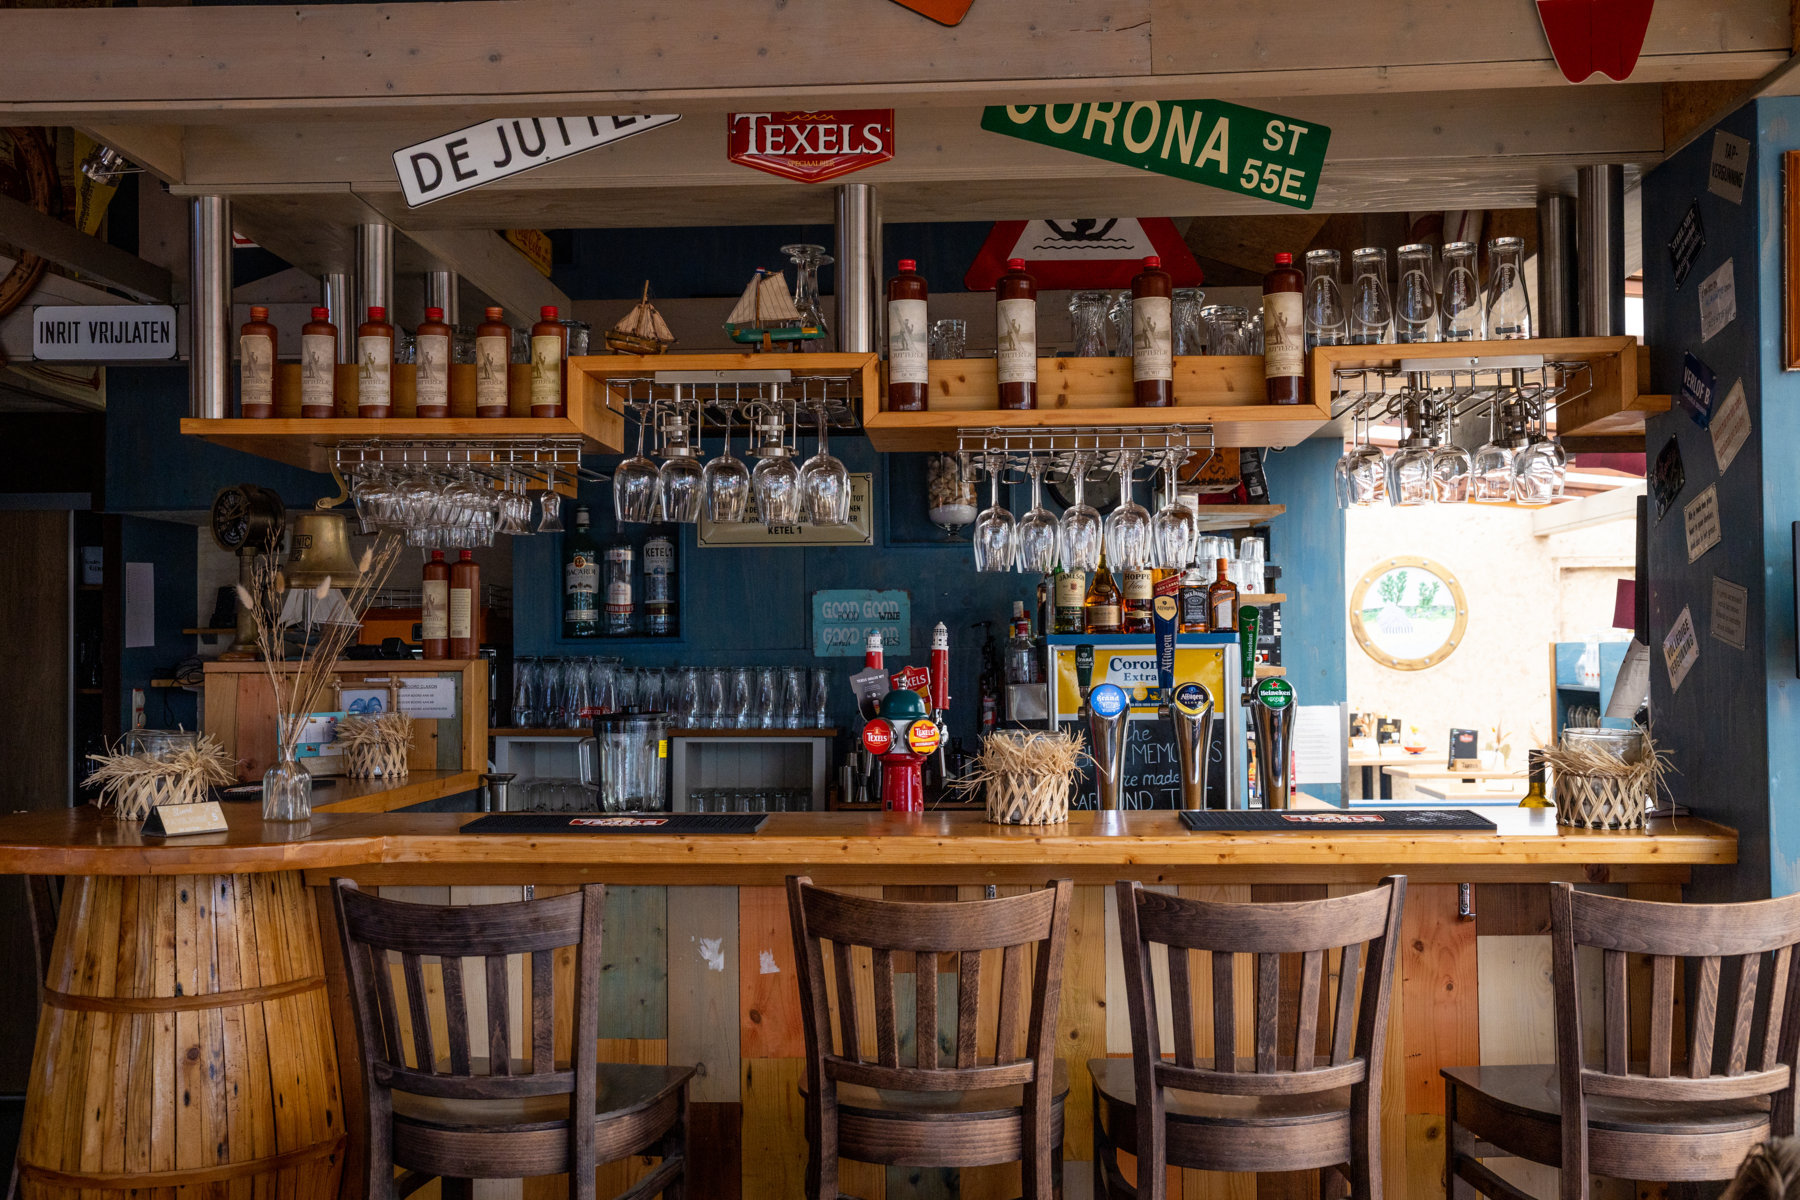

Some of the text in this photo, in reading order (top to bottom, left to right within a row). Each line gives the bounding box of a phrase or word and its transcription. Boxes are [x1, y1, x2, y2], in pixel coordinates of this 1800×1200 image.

[734, 112, 884, 156] TEXELS
[1262, 120, 1309, 156] ST
[1725, 142, 1739, 160] TAP-
[410, 138, 478, 194] DE
[1240, 158, 1307, 202] 55E.
[40, 321, 170, 344] INRIT VRIJLATEN
[1683, 366, 1706, 400] VERLOF
[1703, 386, 1712, 406] B
[768, 526, 802, 535] KETEL 1
[822, 600, 899, 619] GOOD GOOD
[879, 612, 900, 620] WINE
[823, 627, 860, 645] GOOD
[1667, 618, 1690, 661] VOLLEDIGE
[1161, 634, 1173, 673] Affligem
[1246, 633, 1254, 661] Heineken
[1670, 633, 1694, 677] VERGUNNING
[1110, 657, 1159, 671] Coron
[893, 674, 927, 688] TXELS
[1124, 672, 1157, 681] Extra
[1181, 693, 1203, 701] Affligem
[867, 732, 888, 742] TEXELS
[915, 728, 935, 737] TEXELS
[1143, 769, 1180, 786] made
